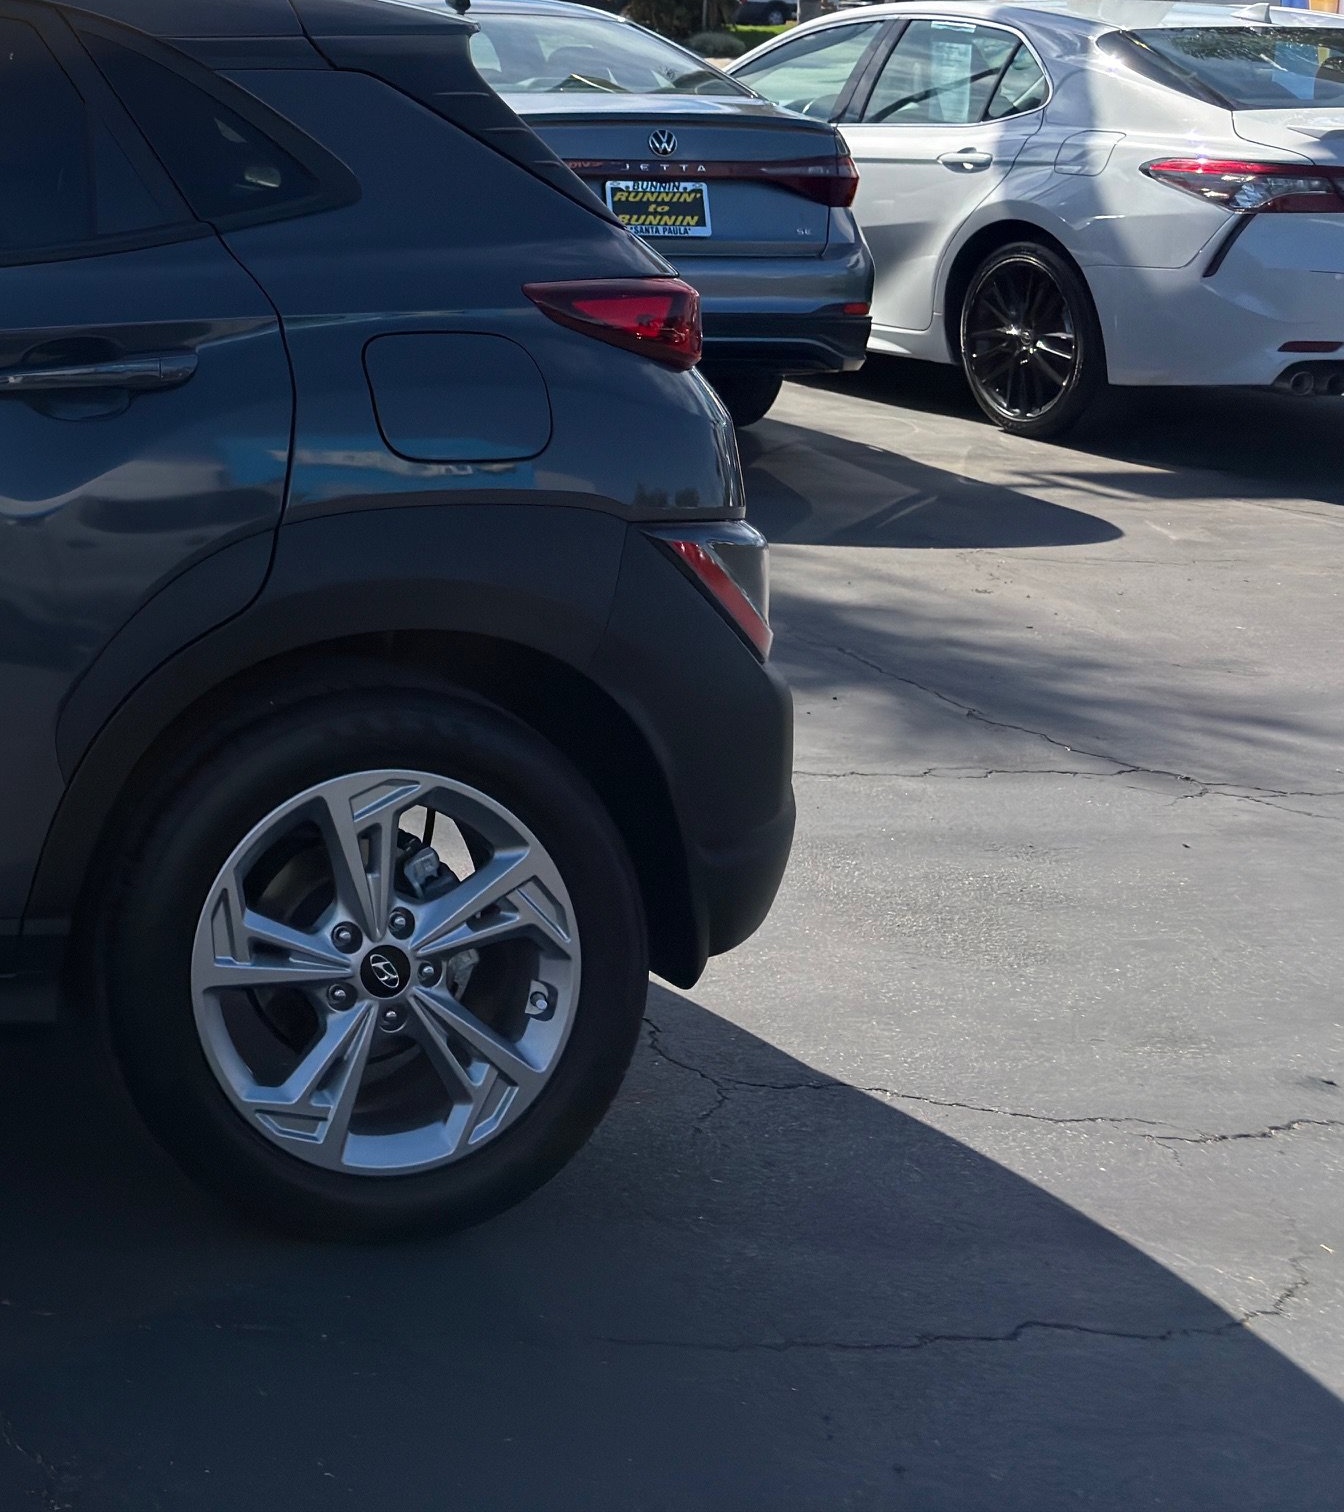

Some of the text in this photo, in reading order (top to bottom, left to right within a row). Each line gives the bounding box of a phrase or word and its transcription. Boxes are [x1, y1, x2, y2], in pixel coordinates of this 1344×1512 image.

[621, 163, 707, 172] JETTA
[613, 191, 701, 202] RUNNIN'
[648, 202, 670, 213] to
[618, 215, 698, 226] BUNNIN
